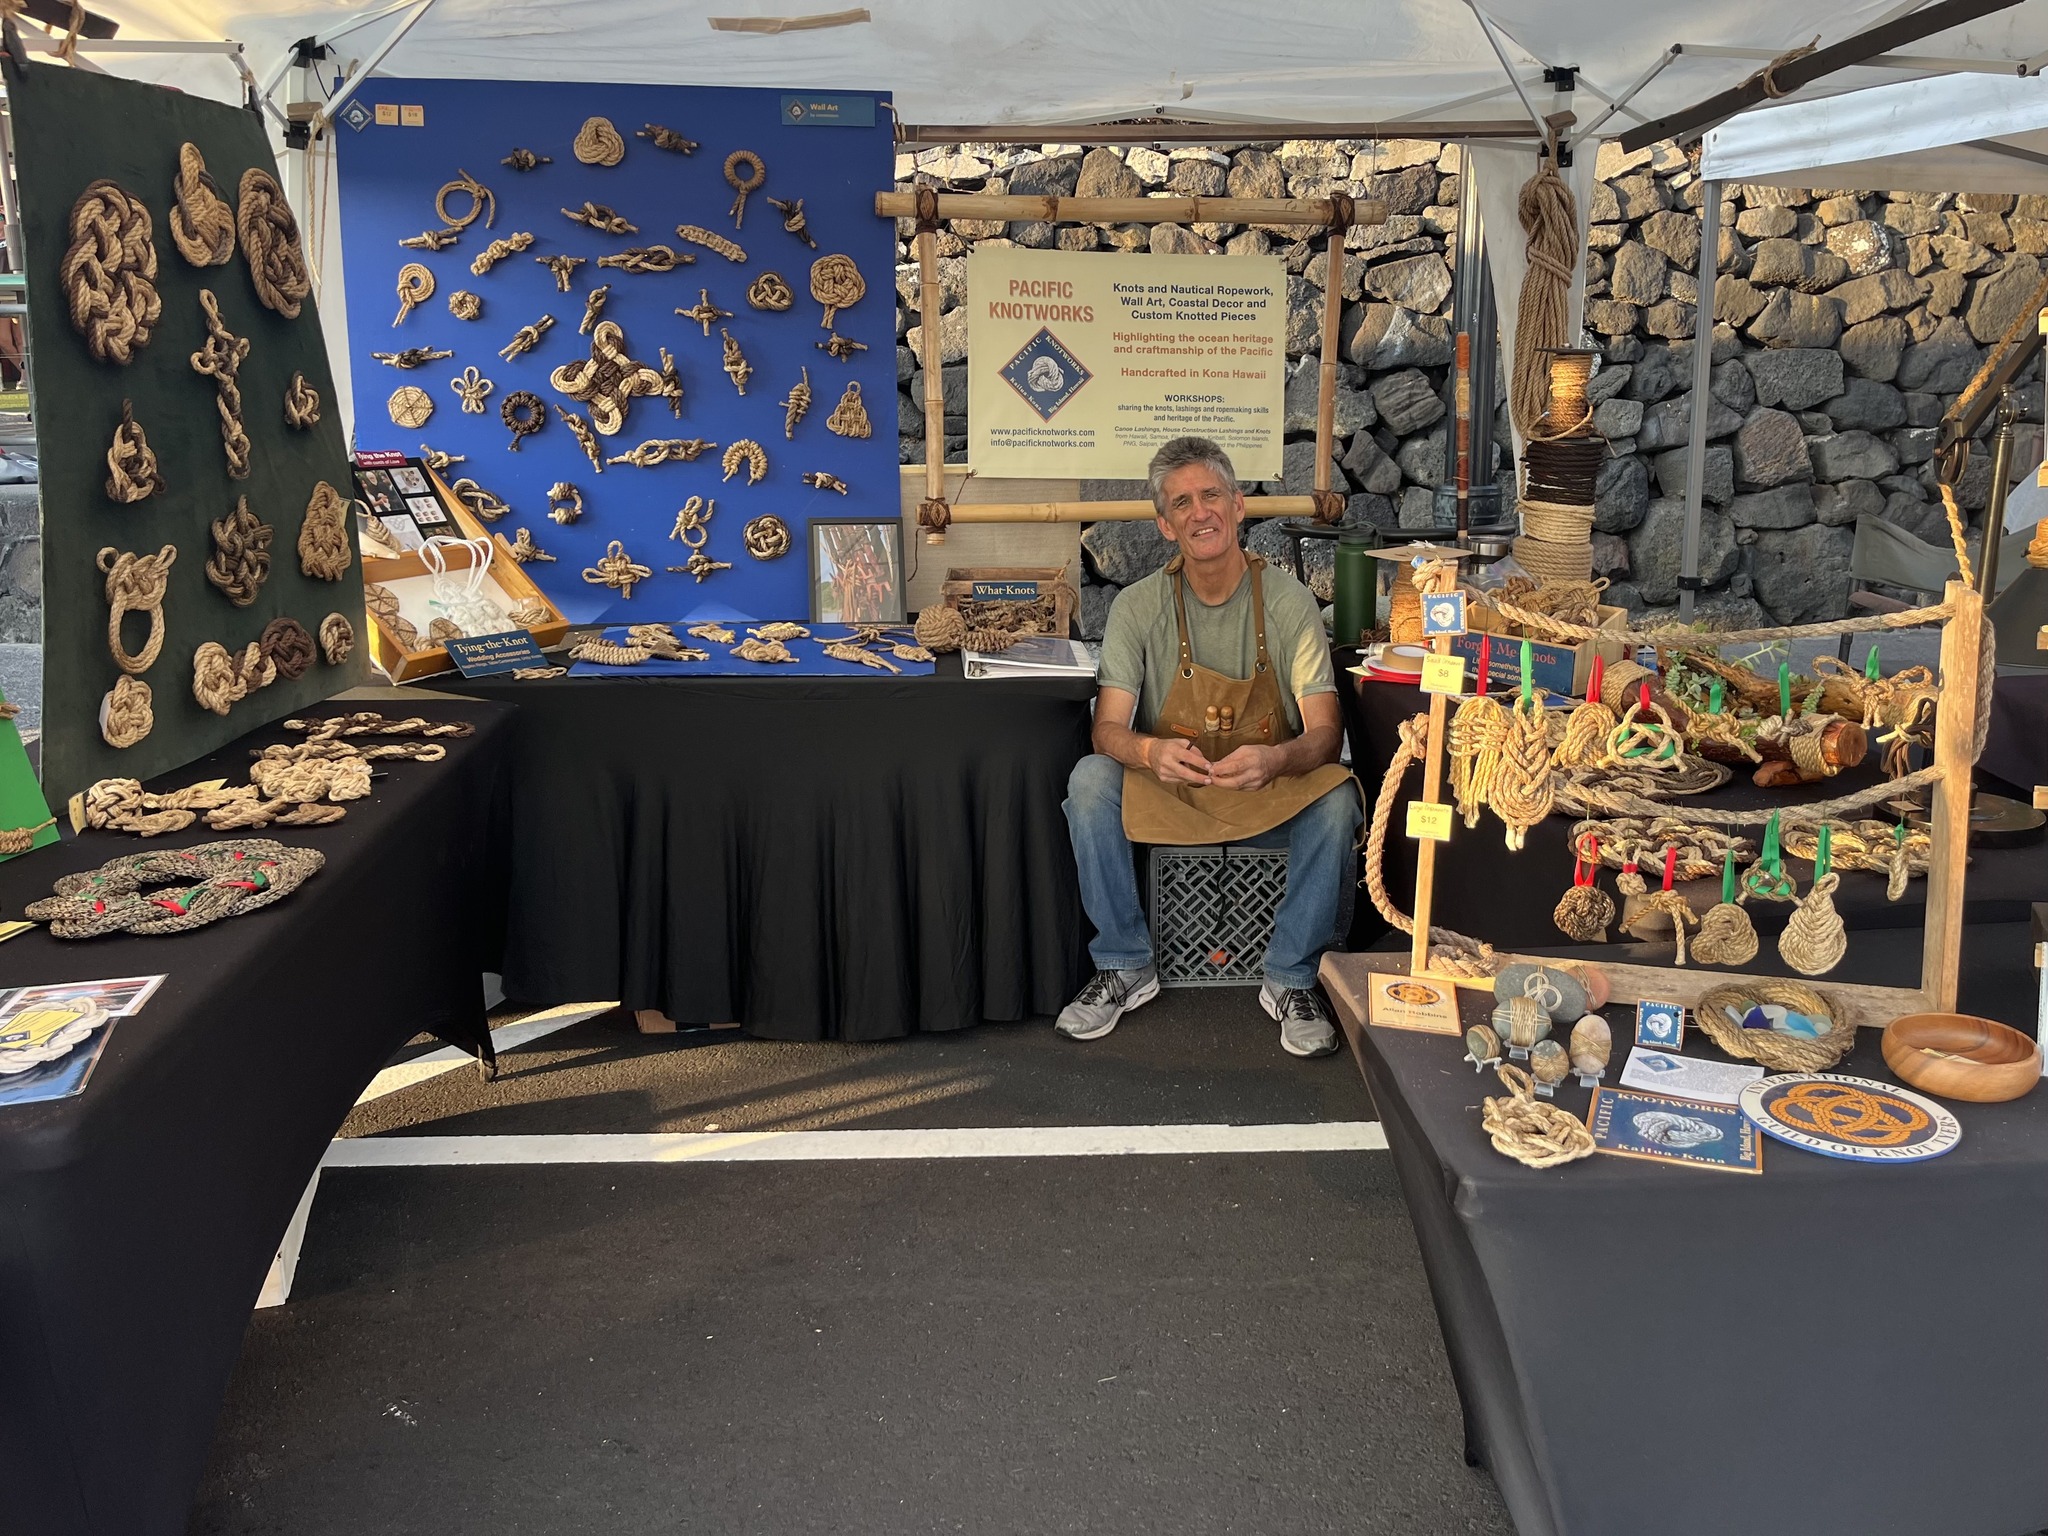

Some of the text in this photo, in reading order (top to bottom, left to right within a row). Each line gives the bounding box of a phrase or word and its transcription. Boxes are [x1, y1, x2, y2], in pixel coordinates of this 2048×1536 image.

[1009, 280, 1073, 298] PACIFIC
[1114, 283, 1274, 296] Knots and Nautical Ropework,
[1121, 297, 1266, 308] Wall Art, Coastal Decor and
[989, 302, 1094, 322] KNOTWORKS
[1132, 310, 1256, 320] Custom Knotted Pieces
[1113, 332, 1175, 343] Highlighting
[1178, 333, 1195, 342] the
[1233, 334, 1274, 345] heritage
[1009, 337, 1042, 370] PACIFIC
[1045, 335, 1085, 376] KNOTWORKS
[1114, 345, 1273, 356] and craftmanship of the Pacific
[1121, 367, 1266, 379] Handcrafted in Kona Hawaii
[1010, 377, 1042, 411] Kailua-Kona
[1165, 394, 1225, 403] WORKSHOPS:
[1048, 404, 1058, 414] Big
[990, 428, 1095, 436] www.pacificknotworks.com
[990, 439, 1095, 448] info@pacificknotworks.com
[975, 586, 1035, 594] What-Knots
[454, 637, 529, 655] Tying-the-Knot
[466, 654, 494, 662] Wedding
[495, 649, 531, 658] Accessories
[1438, 669, 1449, 677] $8
[1488, 661, 1521, 673] something
[1488, 671, 1506, 680] pecial
[1421, 816, 1437, 824] $12
[1646, 1002, 1677, 1010] PACIFIC
[1408, 1010, 1447, 1019] Robbins
[1748, 1073, 1901, 1095] INTERNATIONAL
[1617, 1093, 1737, 1115] KNOTWORKS
[1595, 1097, 1614, 1139] PACIFIC
[1756, 1116, 1957, 1157] GUILD OF KNOT TYERS
[1618, 1143, 1725, 1164] Kailua-Kona
[1740, 1152, 1755, 1161] Big
